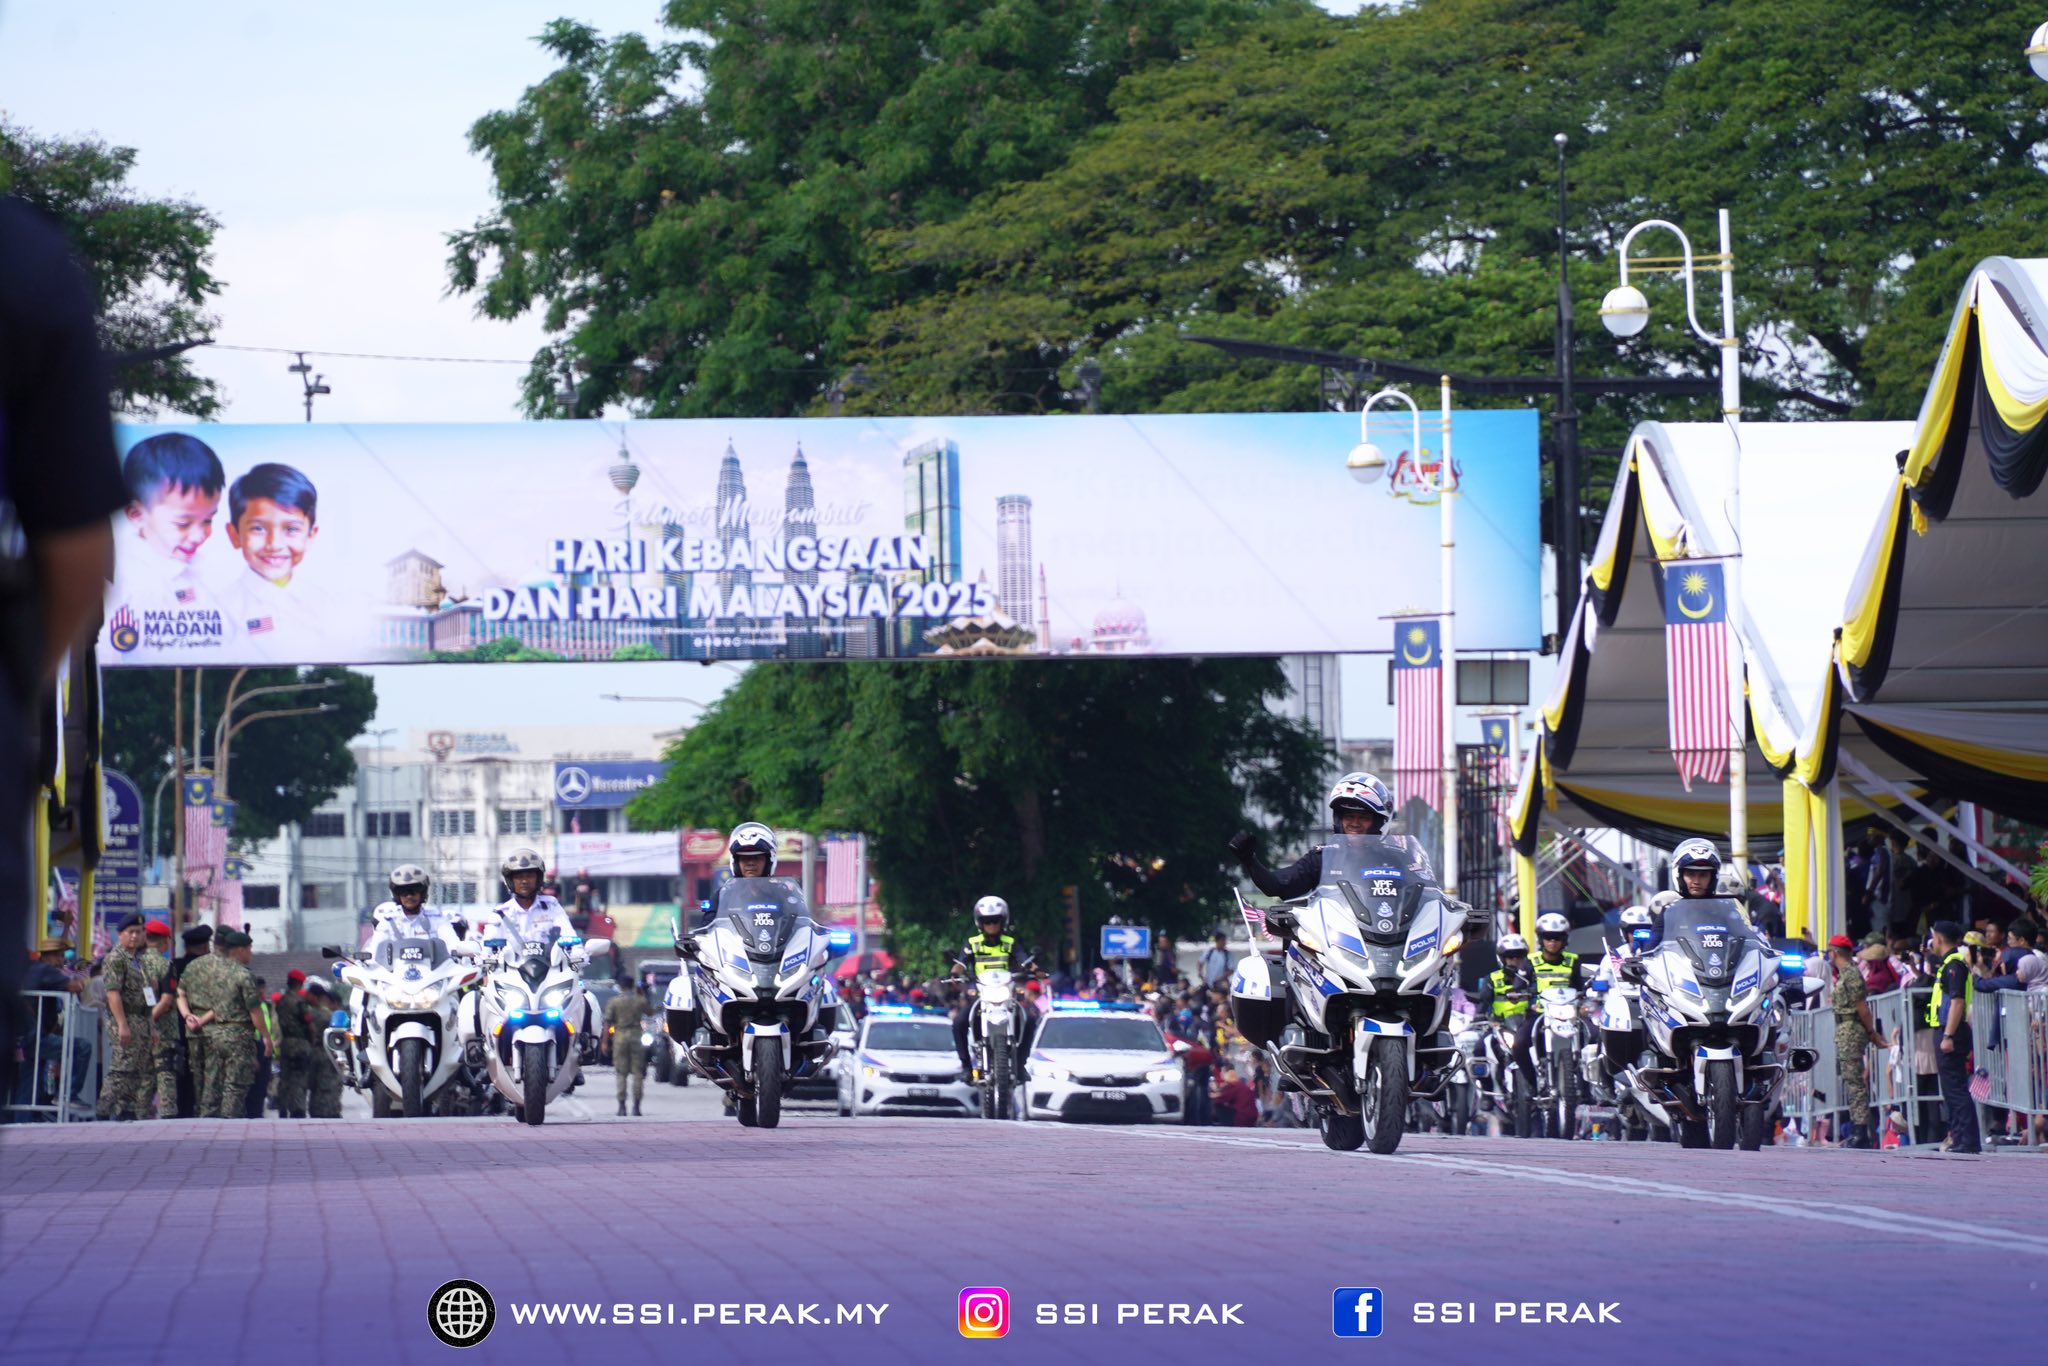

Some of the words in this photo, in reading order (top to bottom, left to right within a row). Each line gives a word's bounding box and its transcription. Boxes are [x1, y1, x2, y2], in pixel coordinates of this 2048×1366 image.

[549, 539, 645, 573] HARI
[655, 535, 929, 573] KEBANGSAAN
[483, 586, 576, 620] DAN
[581, 585, 678, 620] HARI
[688, 583, 889, 619] MALAYSIA
[899, 581, 995, 618] 2025
[144, 610, 221, 621] MALAYSIA
[144, 622, 222, 636] MADANI
[1363, 869, 1401, 878] POLIS
[1373, 880, 1394, 888] VPF
[1371, 887, 1397, 897] 7034
[1409, 935, 1437, 952] POLIS
